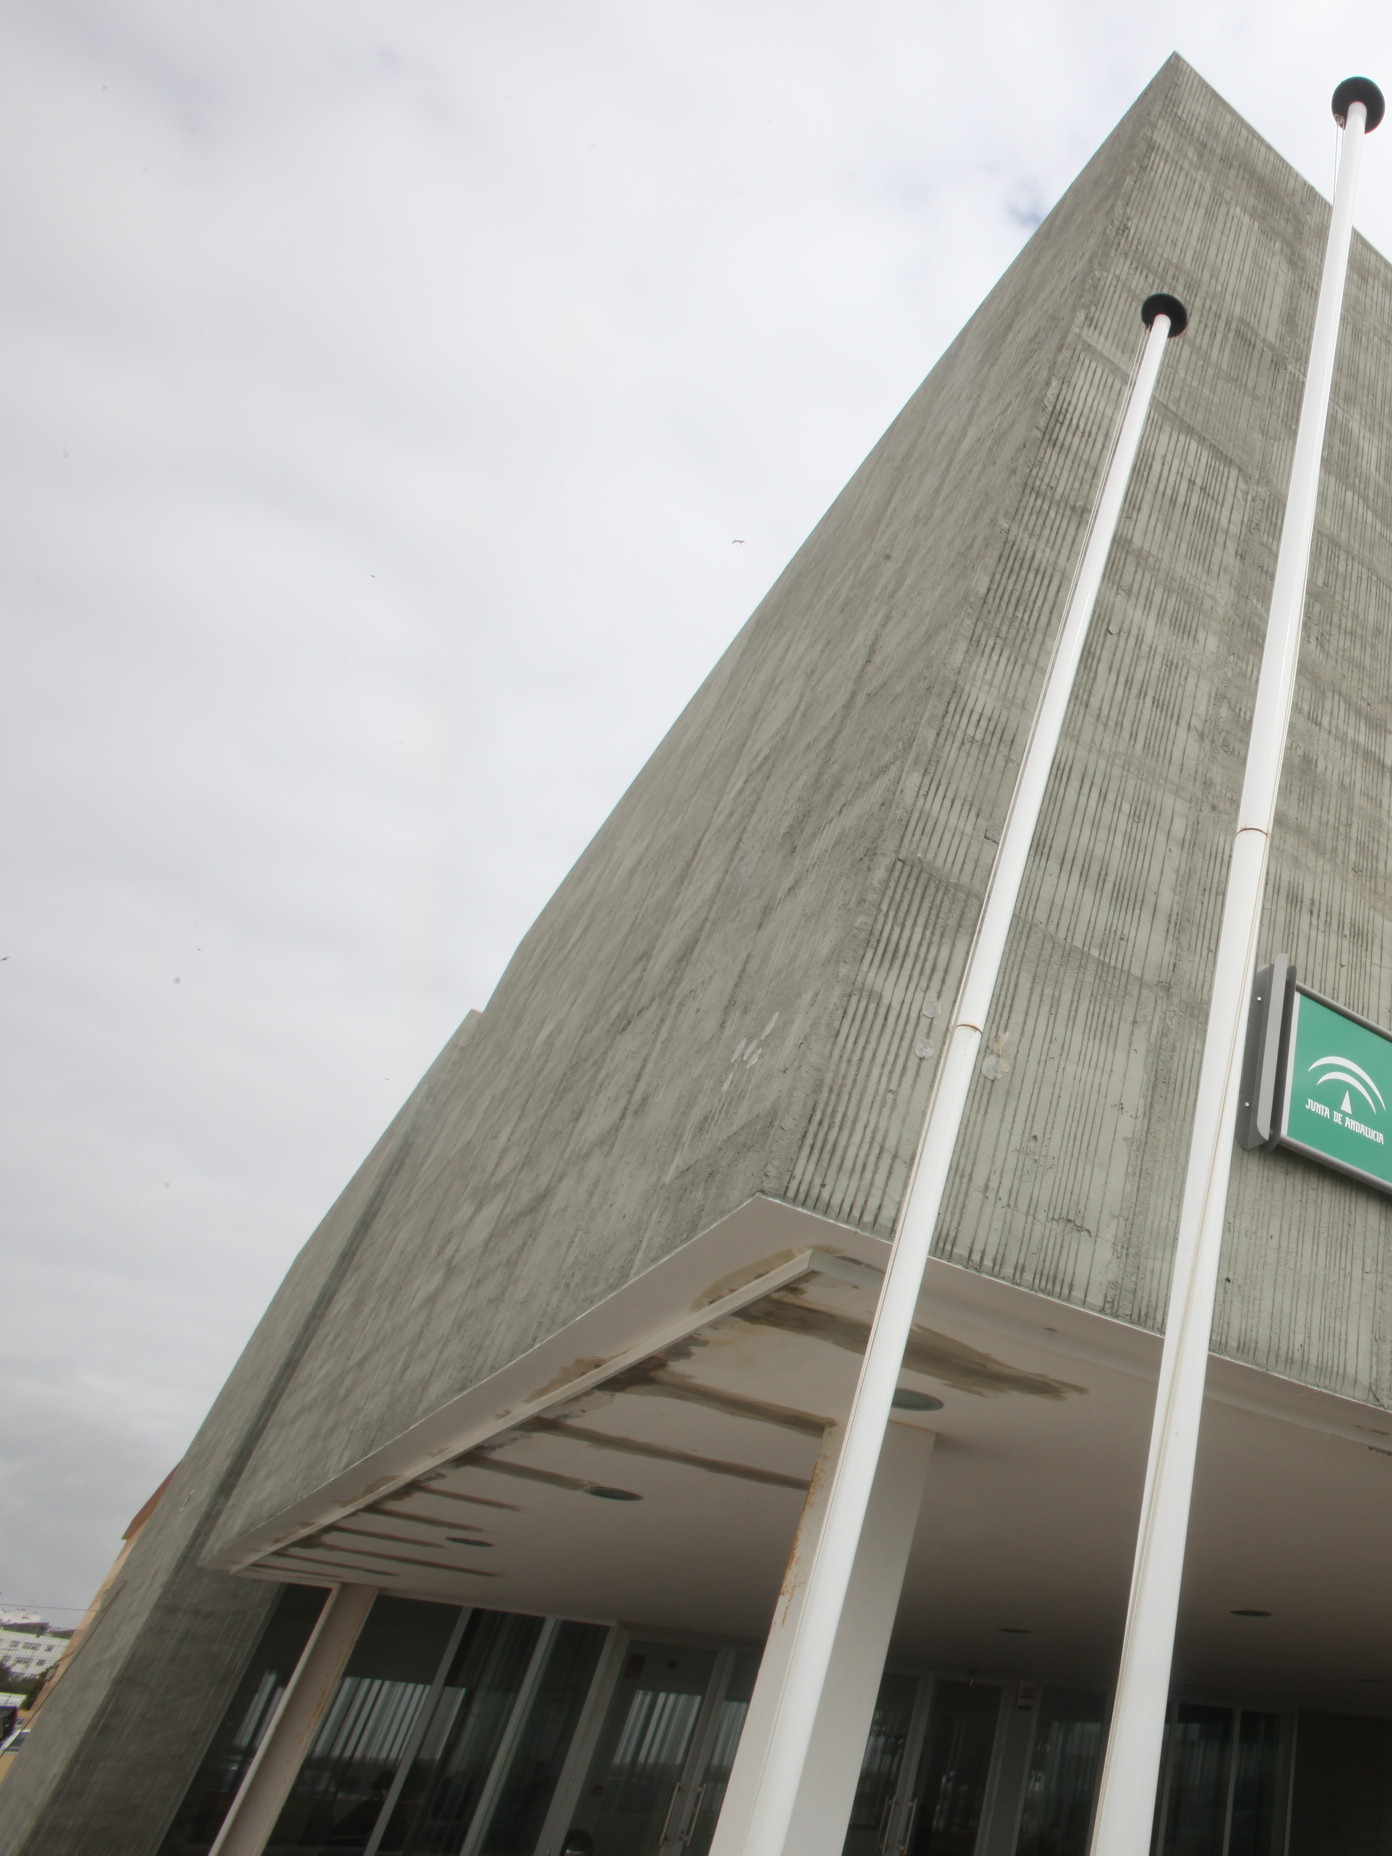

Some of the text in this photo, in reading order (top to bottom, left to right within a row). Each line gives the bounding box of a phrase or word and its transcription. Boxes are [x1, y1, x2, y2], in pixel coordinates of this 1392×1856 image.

[1305, 1098, 1384, 1145] JUNTA DE ANDALUCIA
